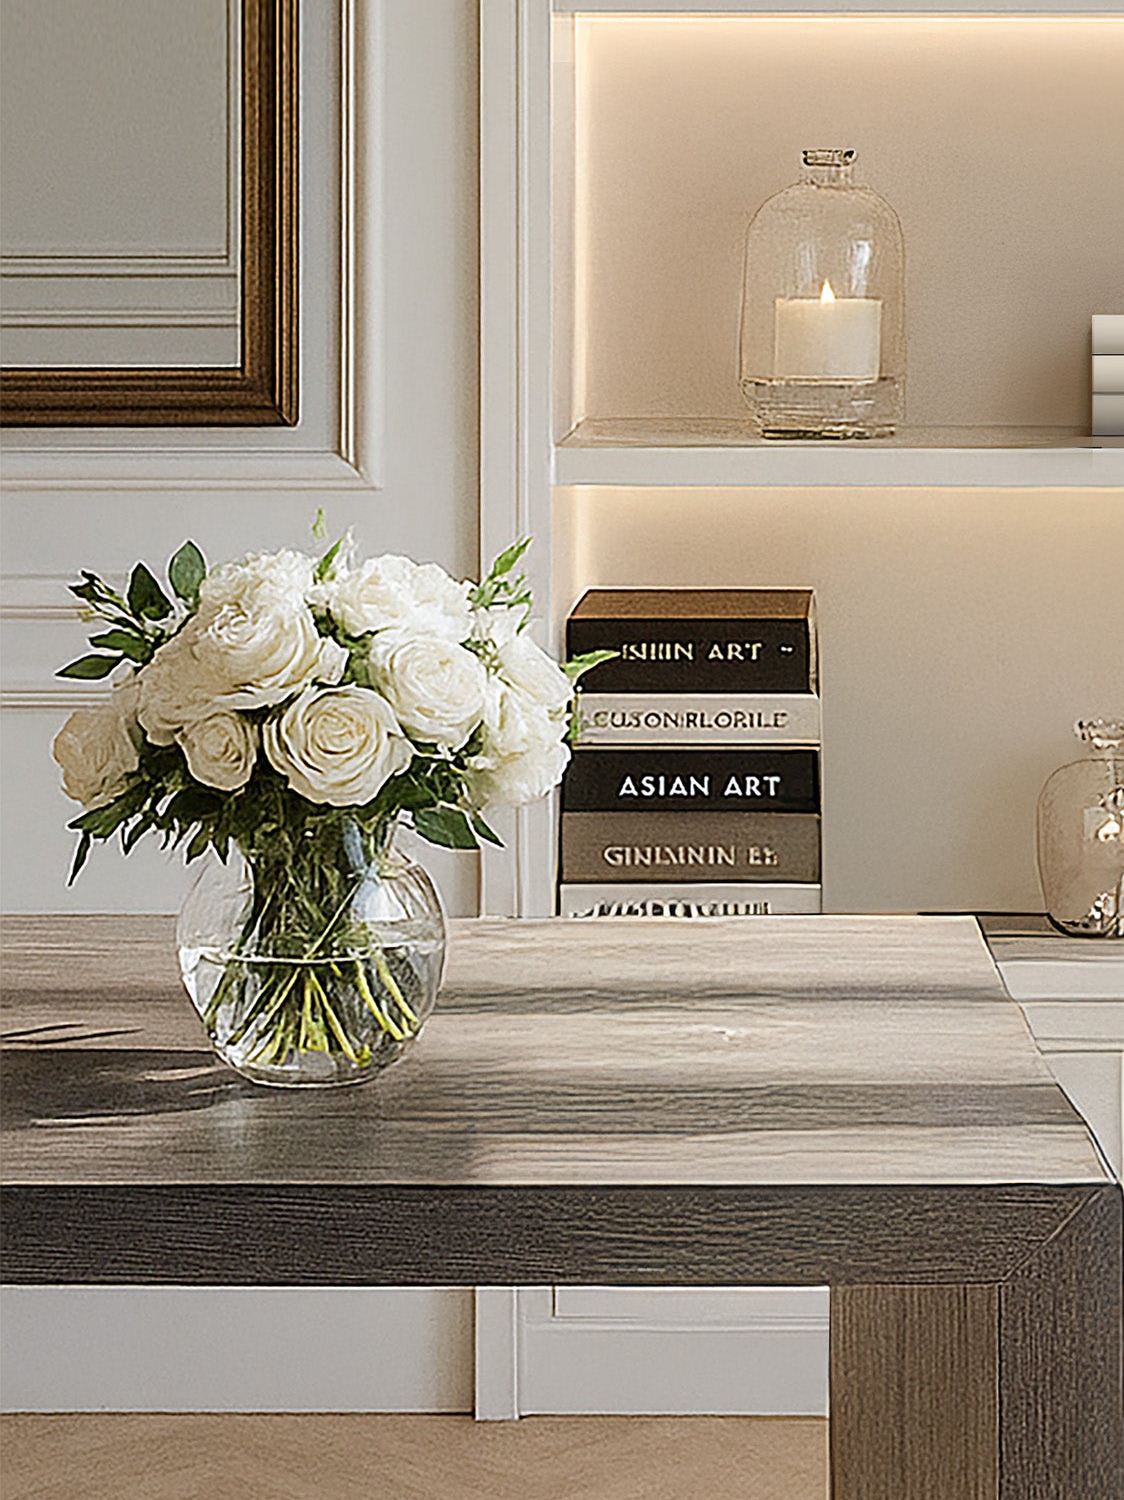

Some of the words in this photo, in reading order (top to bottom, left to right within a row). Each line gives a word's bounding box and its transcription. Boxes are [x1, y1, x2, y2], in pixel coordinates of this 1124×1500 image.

[707, 642, 763, 661] ART
[618, 775, 710, 797] ASIAN
[723, 775, 782, 797] ART
